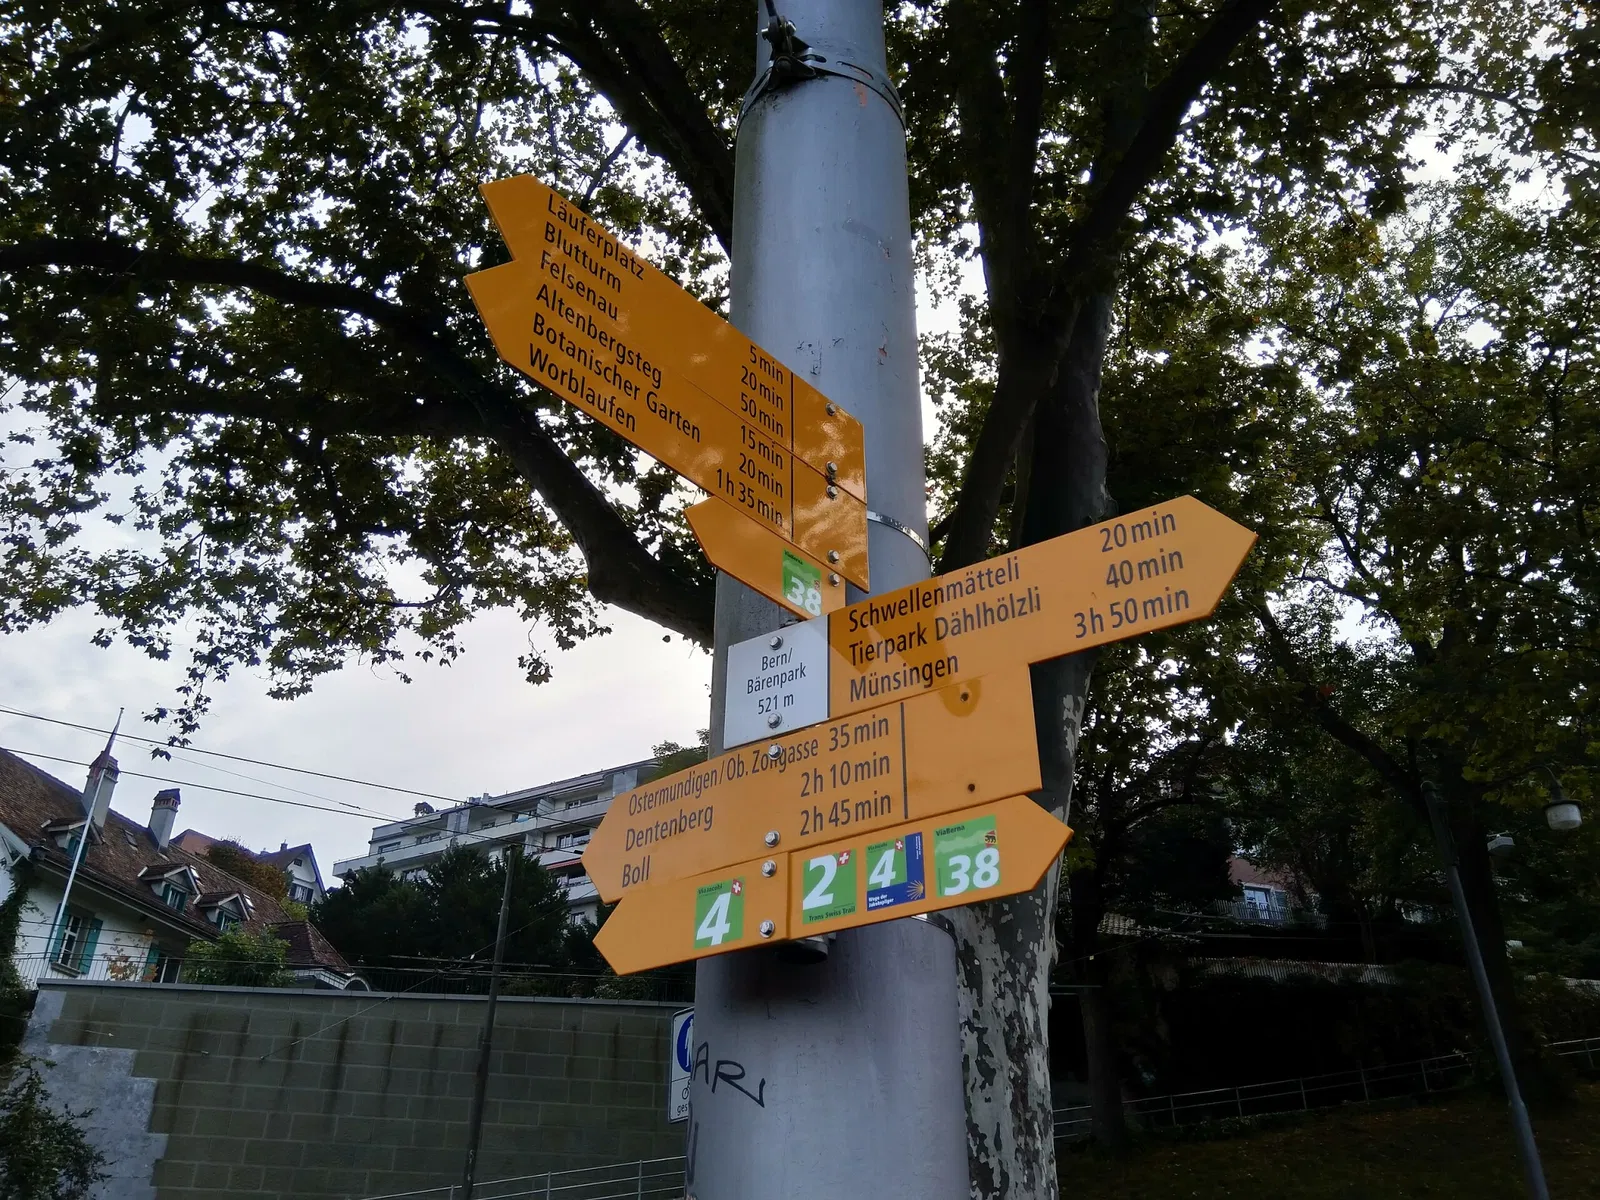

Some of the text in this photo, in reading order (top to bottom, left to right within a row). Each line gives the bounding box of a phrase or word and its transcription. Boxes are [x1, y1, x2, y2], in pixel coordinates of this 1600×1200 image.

[544, 221, 622, 294] Blutturm
[547, 194, 645, 281] Läuferplatz
[540, 250, 619, 321] Felsenau
[536, 284, 662, 389] Altenbergsteg
[529, 343, 637, 432] Worblaufen
[533, 312, 701, 443] Botanischer Garten
[787, 575, 821, 617] 38
[849, 556, 1020, 633] Schwellenmätteli
[849, 586, 1041, 667] Tierpark Dählhölzli
[747, 662, 807, 694] Bärenpark
[761, 647, 793, 671] Bern/
[850, 654, 959, 703] Münsingen
[758, 693, 794, 715] 521 m
[625, 805, 714, 852] Dentenberg
[935, 825, 966, 837] ViaBerna
[621, 855, 651, 888] Boll
[802, 854, 838, 911] 2
[868, 848, 897, 889] 4
[944, 847, 1000, 896] 38
[696, 891, 731, 946] 4
[809, 906, 856, 922] Trans Swiss Trail
